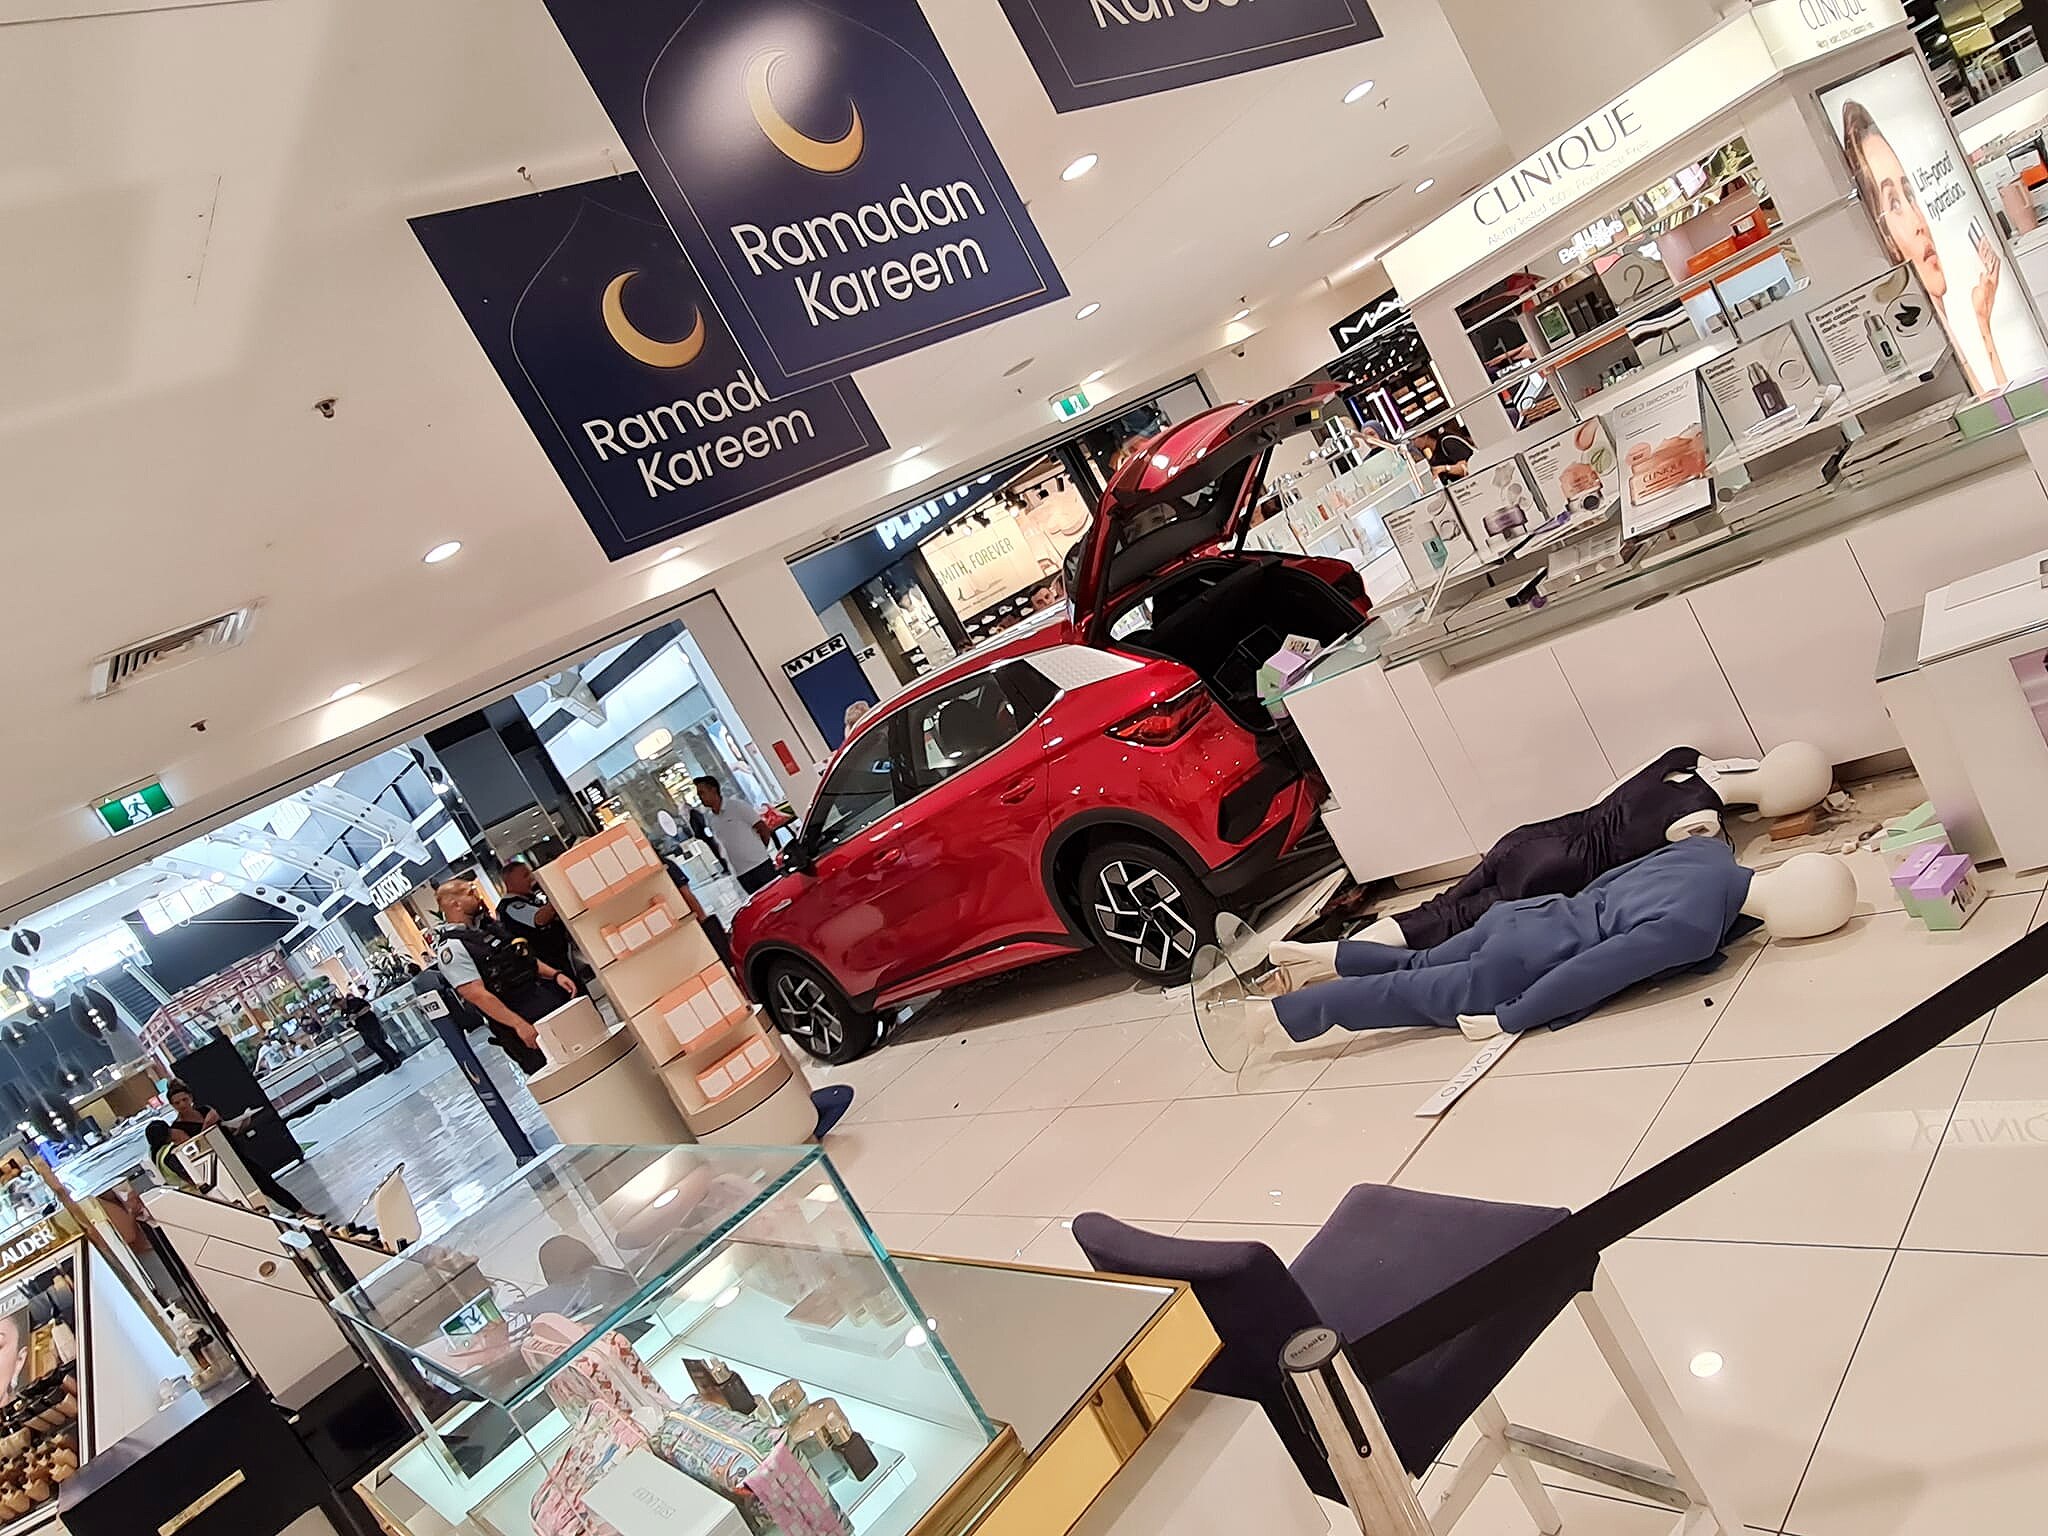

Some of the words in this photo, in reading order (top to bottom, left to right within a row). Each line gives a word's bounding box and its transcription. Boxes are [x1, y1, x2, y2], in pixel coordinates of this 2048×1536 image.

[1472, 98, 1642, 227] CLINIQUE
[730, 180, 986, 277] Ramadan
[793, 235, 991, 328] Kareem
[581, 368, 769, 461] Ramad
[637, 406, 816, 500] Kareem
[968, 536, 1015, 569] FOREVER
[786, 636, 846, 676] MYER
[857, 644, 876, 664] ER
[370, 867, 414, 910] GLASSONS
